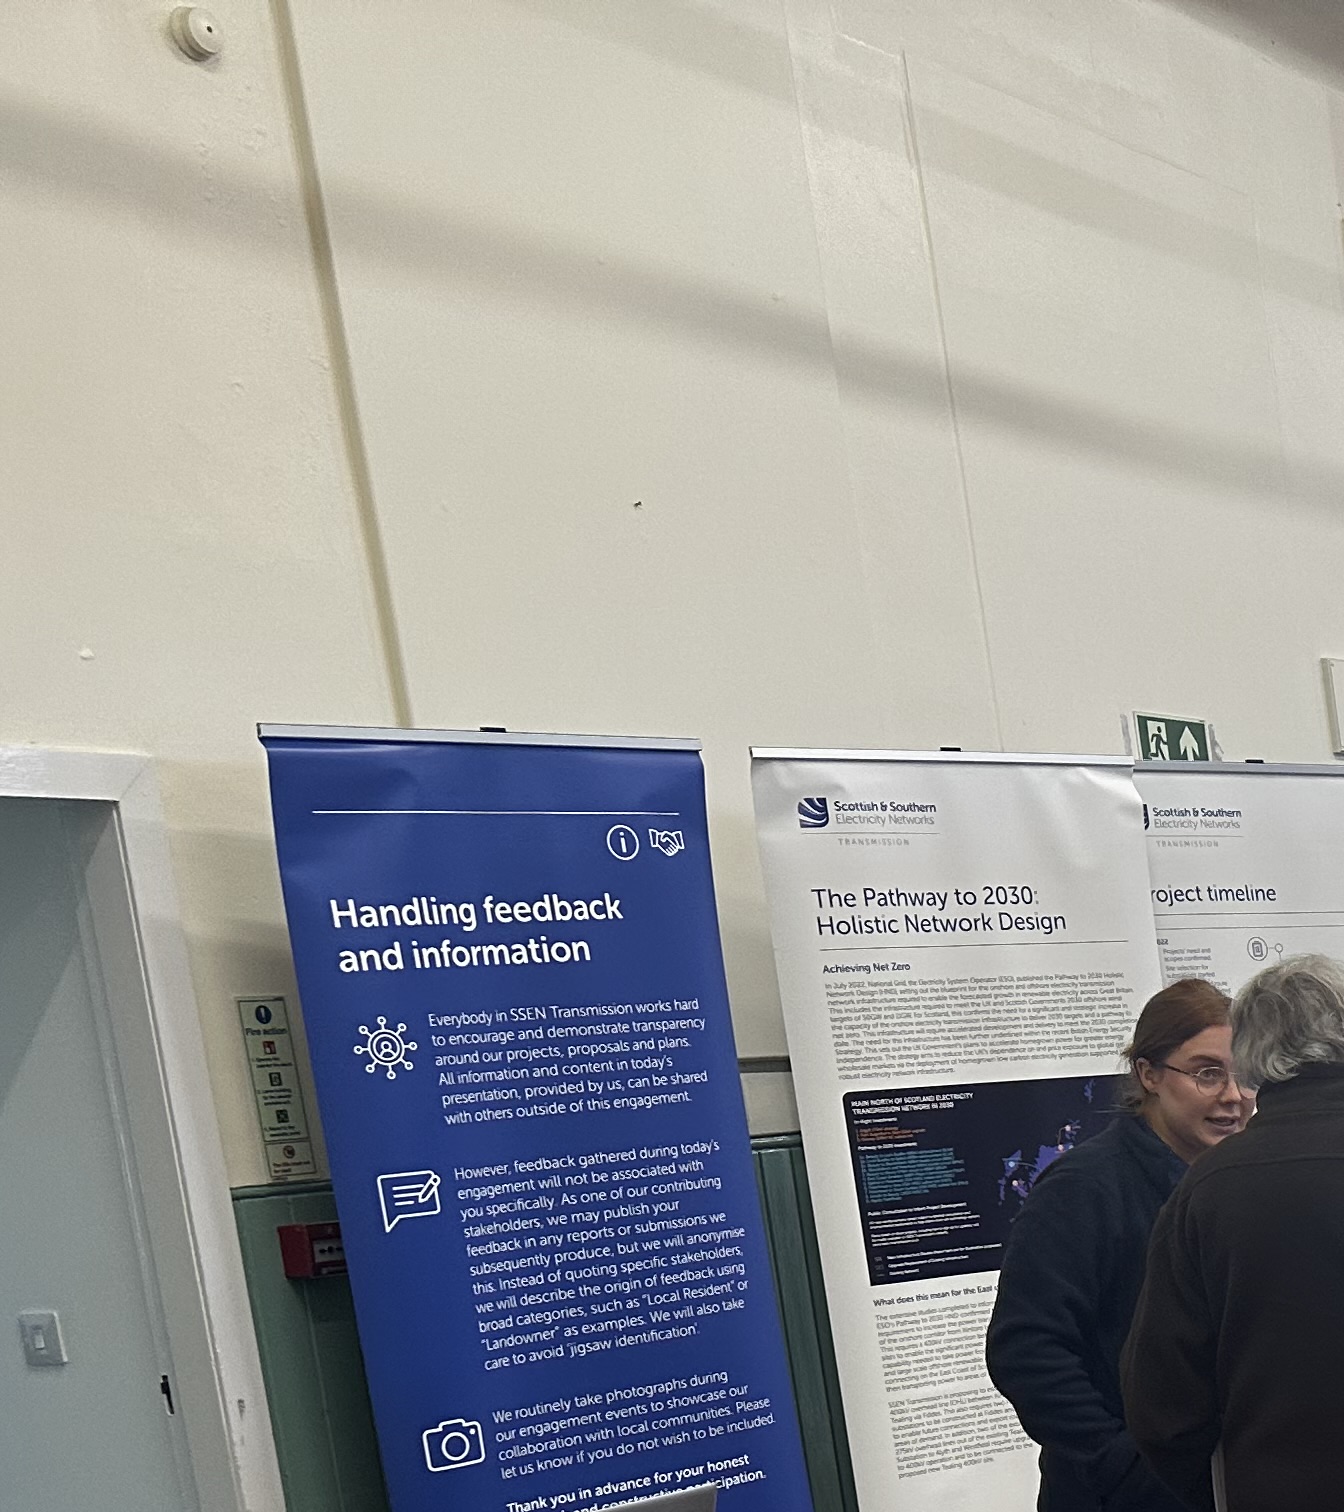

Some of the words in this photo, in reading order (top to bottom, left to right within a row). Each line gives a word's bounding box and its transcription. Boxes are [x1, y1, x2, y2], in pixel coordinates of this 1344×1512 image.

[834, 800, 878, 814] Scottish
[880, 801, 887, 811] &
[889, 801, 936, 812] Southern
[1153, 807, 1191, 817] Scottish
[1193, 808, 1200, 817] &
[1201, 808, 1242, 818] Southern
[835, 813, 886, 826] Electricity
[888, 814, 934, 824] Networks
[1154, 819, 1198, 830] Electricity
[1200, 819, 1240, 828] Networks
[838, 838, 909, 846] TRANSMISSION
[811, 888, 856, 908] The
[863, 888, 947, 911] Pathway
[954, 889, 976, 905] to
[983, 886, 1038, 904] 2030:
[1151, 885, 1203, 906] roject
[1207, 884, 1276, 901] timeline
[330, 897, 476, 931] Handling
[482, 893, 623, 922] feedback
[817, 915, 899, 935] Holistic
[904, 913, 993, 932] Network
[998, 912, 1066, 934] Design
[339, 941, 403, 972] and
[412, 936, 590, 968] information
[823, 964, 871, 974] Achieving
[873, 963, 889, 971] Net
[891, 962, 910, 970] Zero
[428, 1010, 492, 1028] Everybody
[496, 1011, 507, 1021] in
[510, 1007, 546, 1021] SSEN
[549, 1004, 633, 1018] Transmission
[635, 1000, 671, 1013] works
[674, 998, 699, 1010] hard
[431, 1035, 446, 1046] to
[448, 1031, 514, 1045] encourage
[518, 1026, 543, 1040] and
[547, 1022, 629, 1038] demonstrate
[632, 1018, 705, 1032] transparency
[435, 1050, 479, 1066] around
[482, 1051, 502, 1062] our
[506, 1046, 564, 1063] projects,
[568, 1040, 630, 1058] proposals
[632, 1038, 655, 1050] and
[658, 1036, 690, 1051] plans.
[439, 1072, 455, 1085] All
[457, 1068, 529, 1083] information
[532, 1064, 558, 1077] and
[562, 1060, 614, 1074] content
[617, 1061, 628, 1070] in
[630, 1055, 672, 1070] today's
[442, 1089, 521, 1108] presentation,
[524, 1080, 584, 1100] provided
[587, 1080, 603, 1094] by
[607, 1080, 624, 1091] us,
[627, 1078, 650, 1088] can
[652, 1074, 668, 1086] be
[670, 1070, 708, 1084] shared
[444, 1110, 472, 1124] with
[474, 1108, 513, 1121] others
[516, 1102, 566, 1117] outside
[569, 1099, 583, 1112] of
[587, 1098, 610, 1110] this
[613, 1091, 692, 1109] engagement.
[873, 1298, 895, 1306] What
[896, 1296, 914, 1304] does
[916, 1292, 928, 1301] this
[977, 1285, 992, 1293] East
